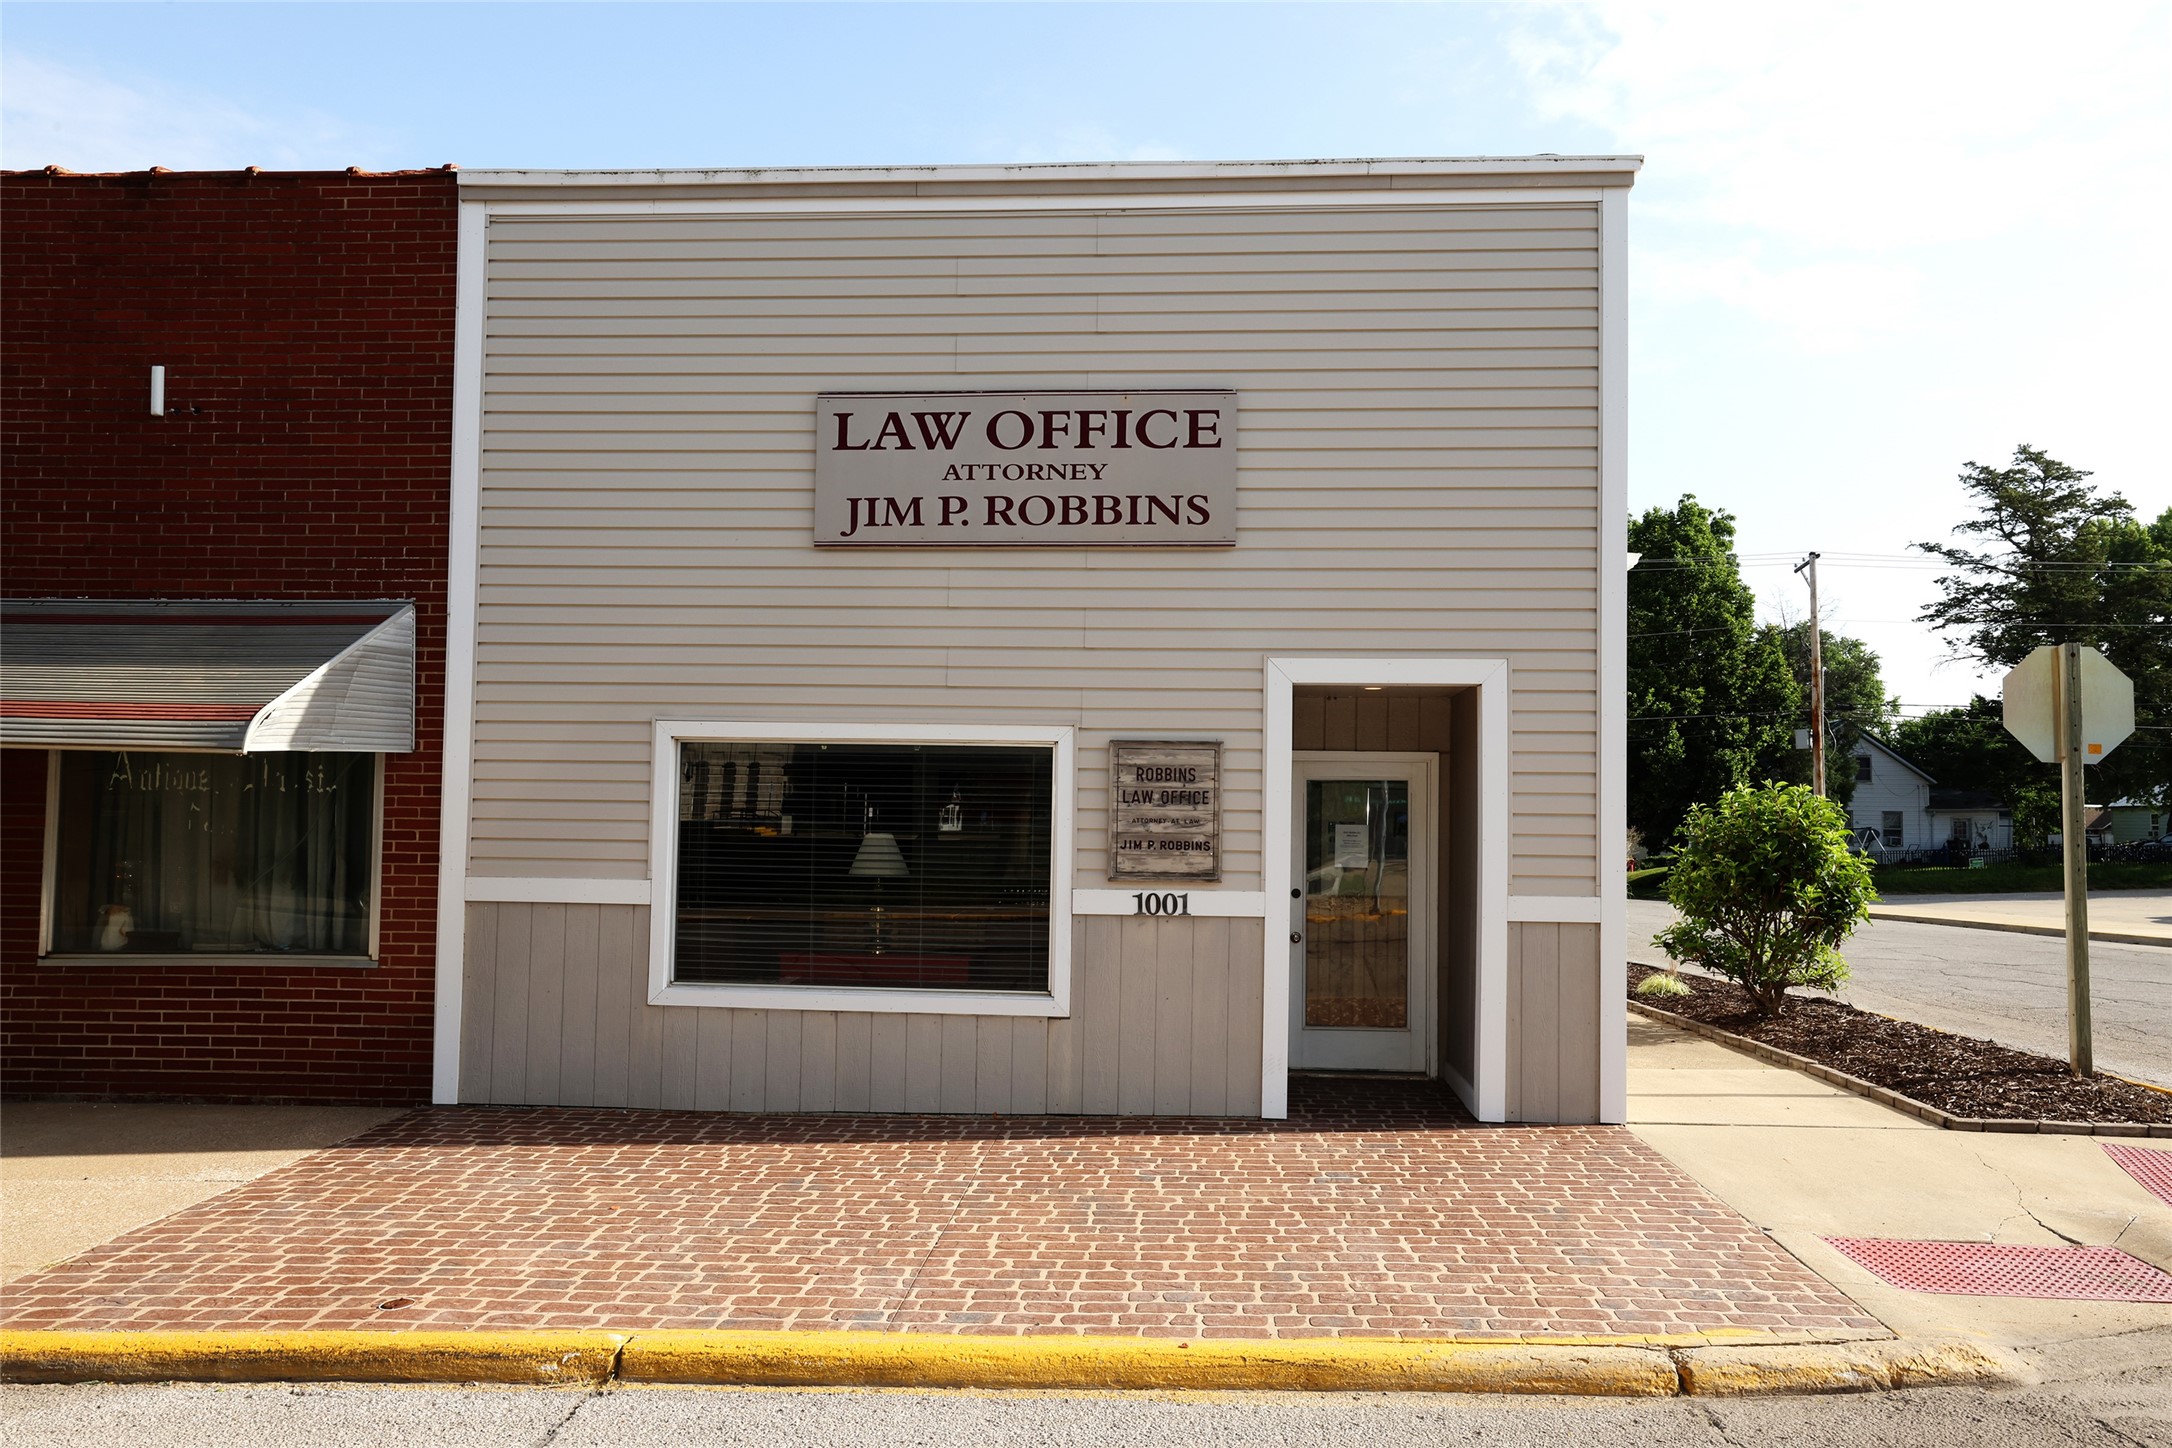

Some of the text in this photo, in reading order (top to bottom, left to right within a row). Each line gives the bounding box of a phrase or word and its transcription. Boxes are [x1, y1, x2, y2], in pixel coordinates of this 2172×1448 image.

[832, 408, 1222, 451] LAW OFFICE
[941, 462, 1108, 481] ATTORNEY
[840, 494, 1211, 537] JIM P. ROBBINS
[1136, 767, 1196, 782] ROBBINS
[1122, 790, 1209, 805] LAW OFFICE
[1120, 840, 1211, 851] JIM P. ROBBINS
[1132, 892, 1191, 916] 1001
